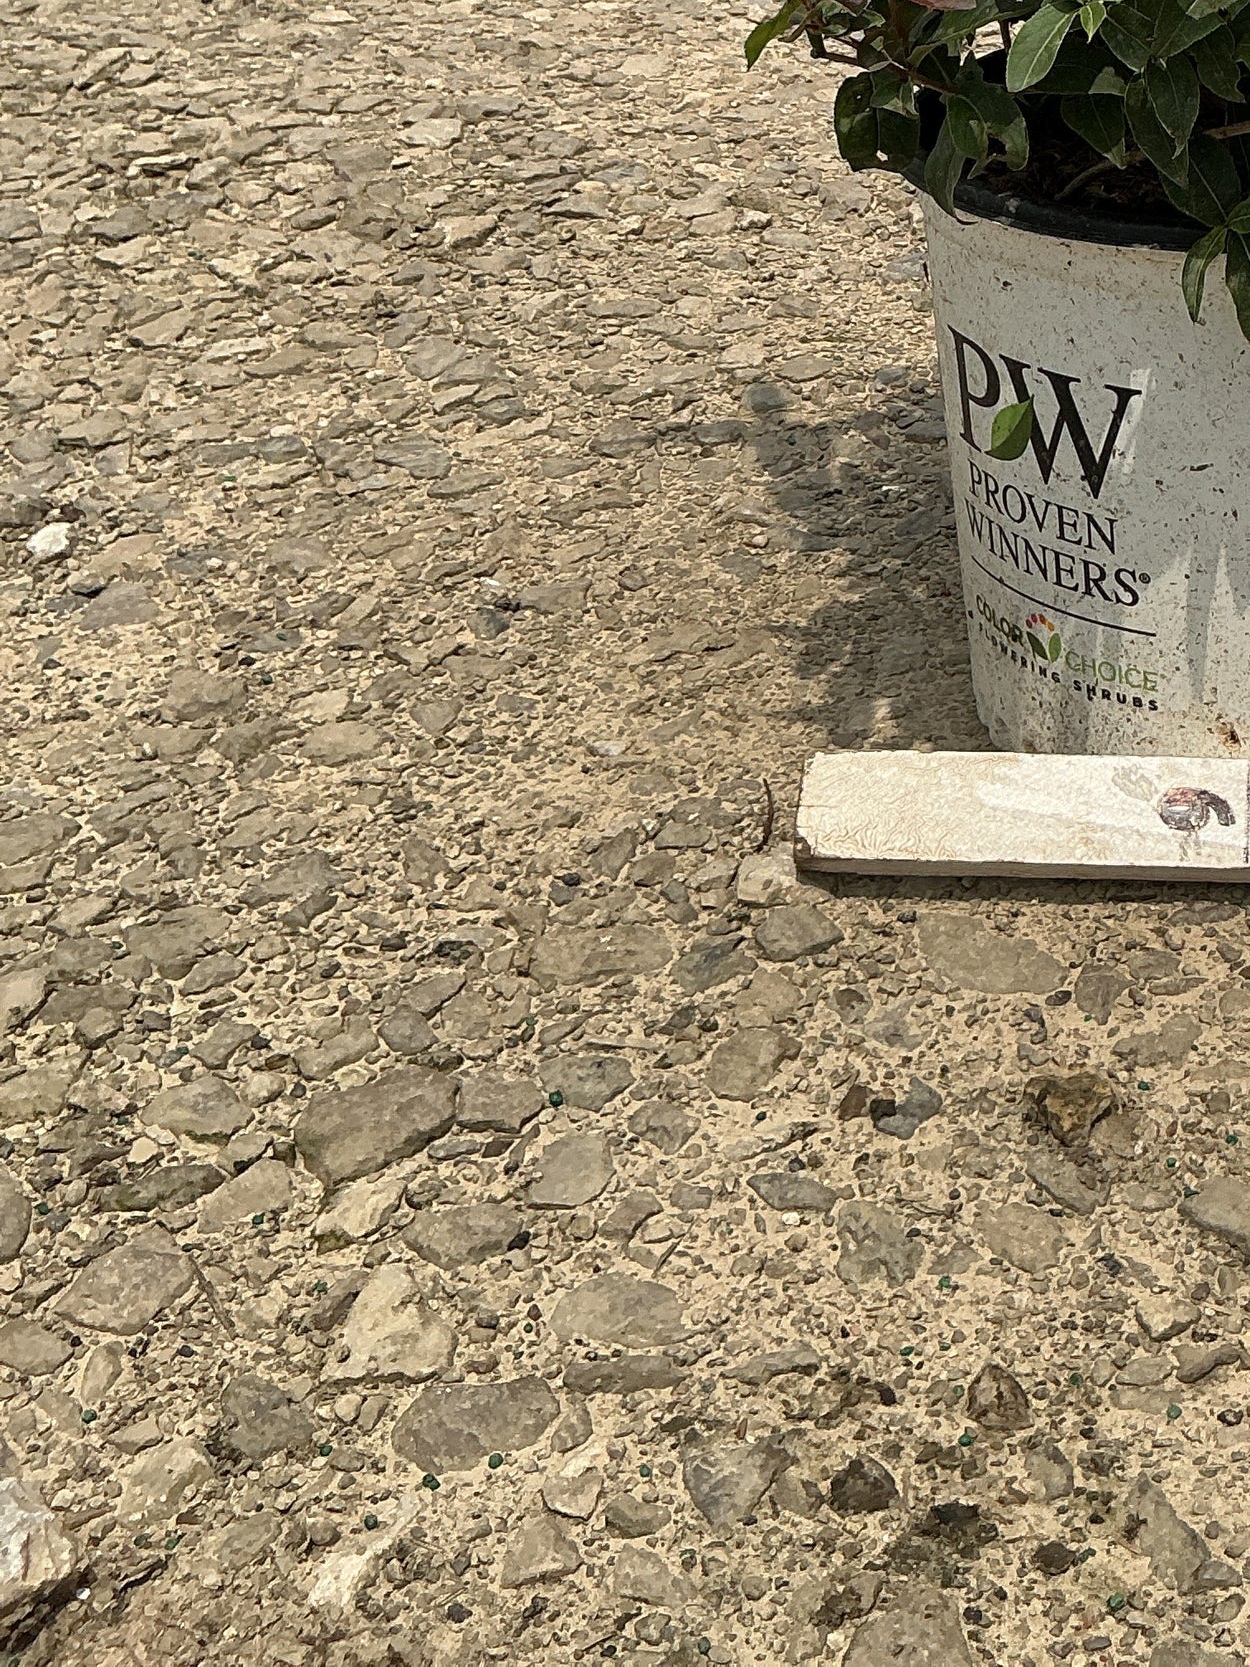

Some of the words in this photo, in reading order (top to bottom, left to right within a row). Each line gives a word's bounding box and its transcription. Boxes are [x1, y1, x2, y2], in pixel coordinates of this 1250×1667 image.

[947, 324, 1142, 500] PW
[967, 458, 1118, 556] PROVEN
[975, 593, 1025, 648] COLOR
[1064, 650, 1160, 694] CHOICE
[1073, 678, 1160, 712] SHRUBS
